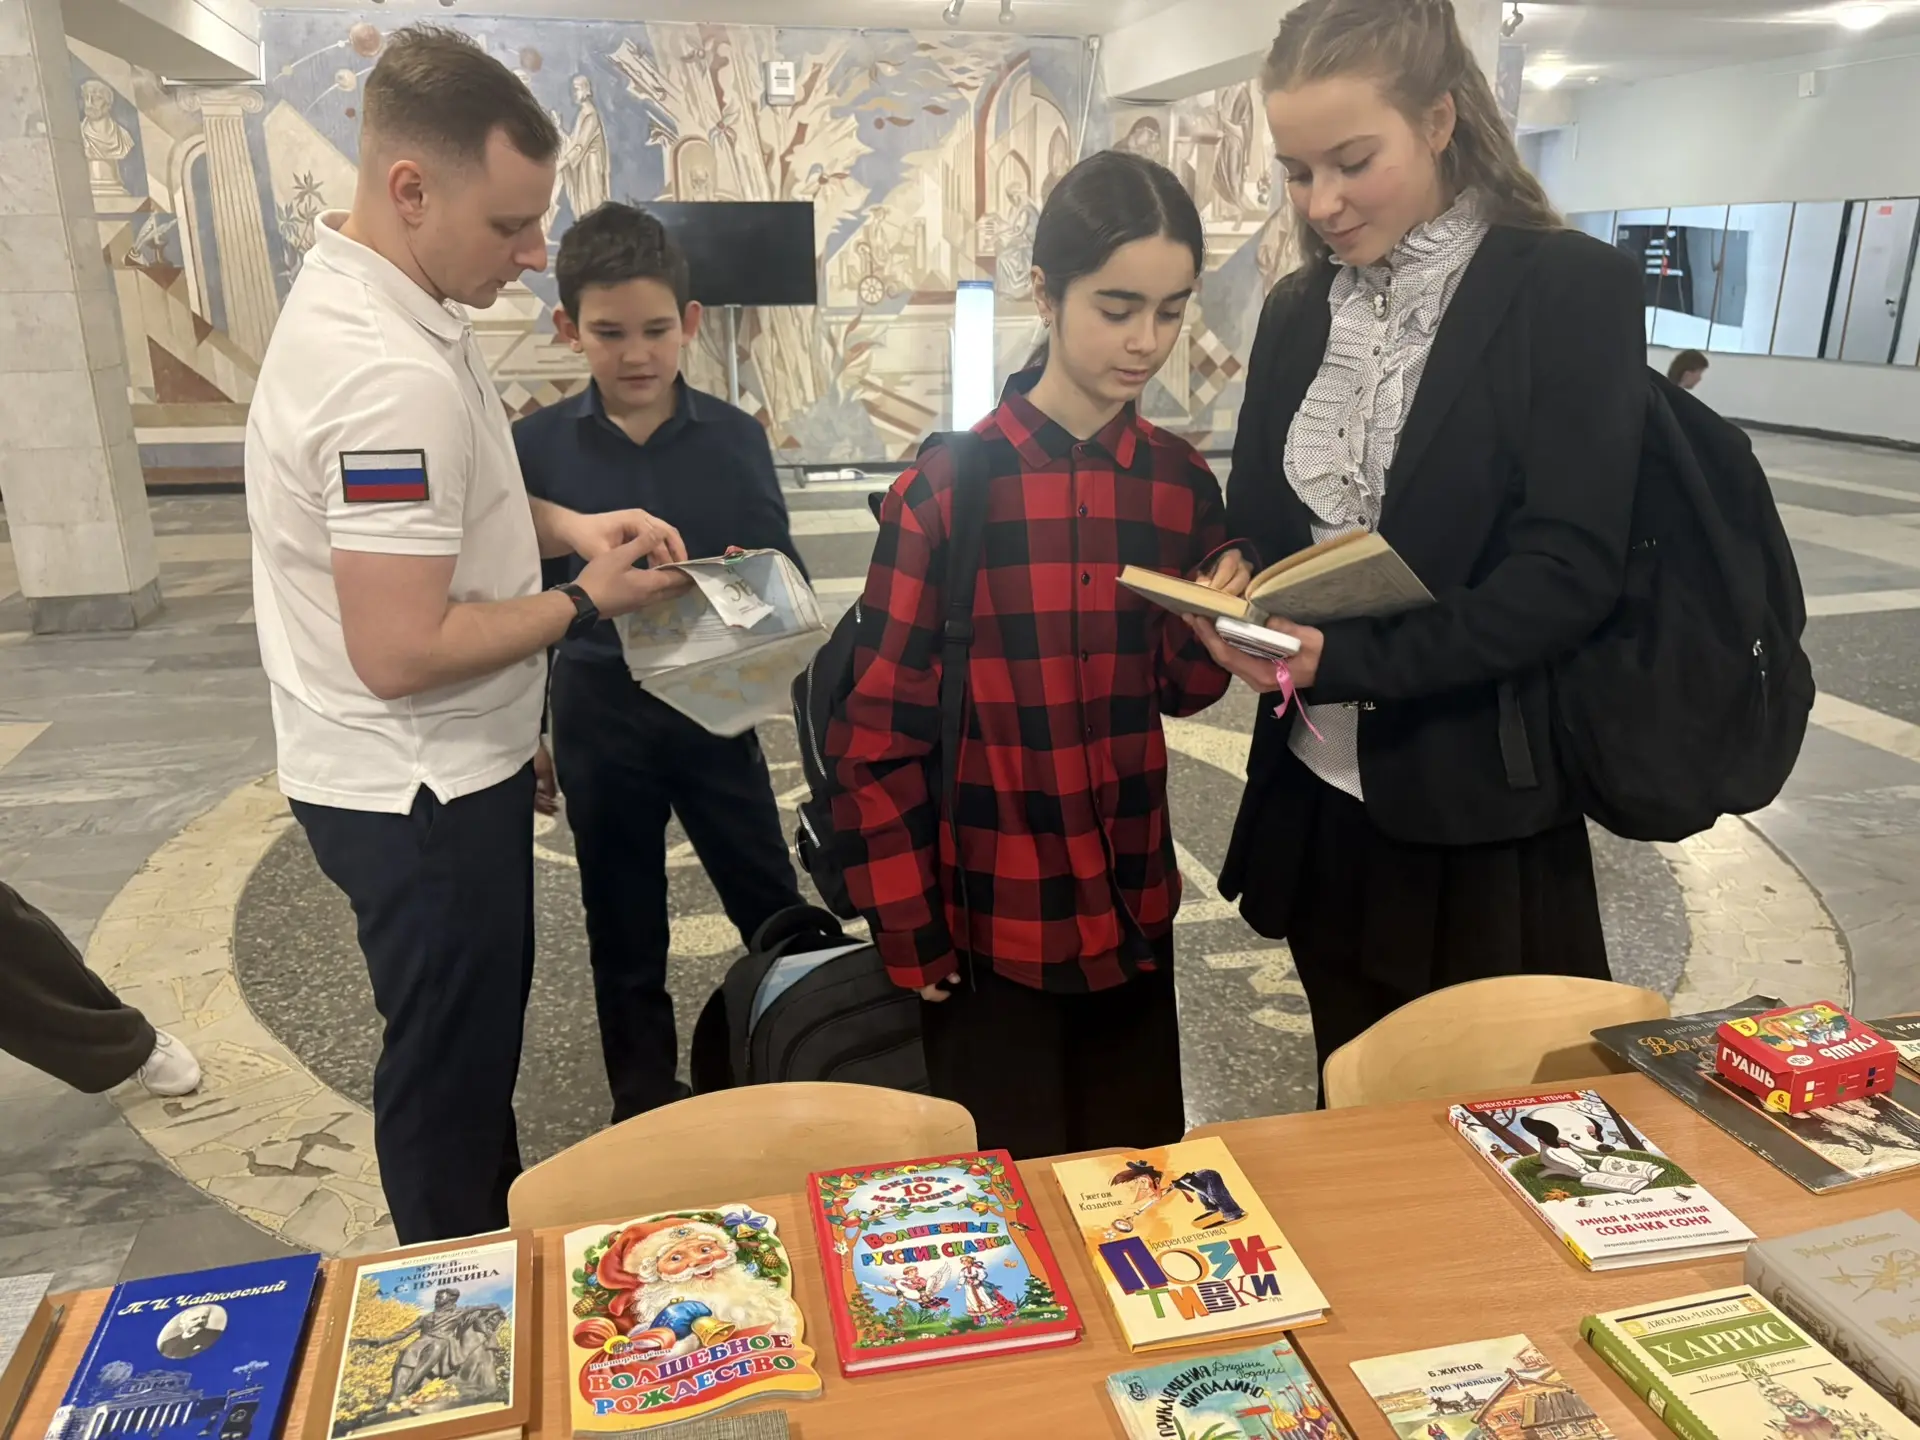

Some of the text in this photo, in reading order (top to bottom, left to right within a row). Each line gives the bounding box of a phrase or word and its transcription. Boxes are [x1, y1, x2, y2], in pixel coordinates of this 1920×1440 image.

[1819, 1034, 1879, 1060] ГУАШЬ
[1721, 1046, 1776, 1089] ГУАШЬ
[1475, 1093, 1573, 1110] ВНЕКЛАССНОЕ ЧТЕНИЕ
[1777, 1093, 1785, 1103] 6
[901, 1183, 932, 1197] 10
[1576, 1204, 1710, 1227] УМНАЯ И ЗНАМЕНИТАЯ
[1595, 1215, 1712, 1236] СОБАЧКА СОНЯ
[860, 1234, 1012, 1267] РУССКИЕ СКАЗКИ
[394, 1283, 409, 1294] С.
[413, 1268, 501, 1291] ПУШКИНА
[396, 1263, 480, 1283] ЗАПОВЕДНИК
[175, 1279, 288, 1306] Чайковский
[1135, 1273, 1282, 1321] ТИВКИ
[1691, 1303, 1741, 1320] ЧАНДЛЕР
[1648, 1321, 1797, 1368] ХАРРИС
[589, 1334, 793, 1393] ВОЛШЕБНОЕ
[1427, 1362, 1484, 1378] Б.ЖИТКОВ
[593, 1354, 797, 1416] РОЖДЕСТВО
[1179, 1379, 1265, 1410] ЧИПОЛЛИНО
[1429, 1375, 1504, 1394] Про умельцев
[1155, 1365, 1212, 1439] ПРИКЛЮЧЕНИЯ
